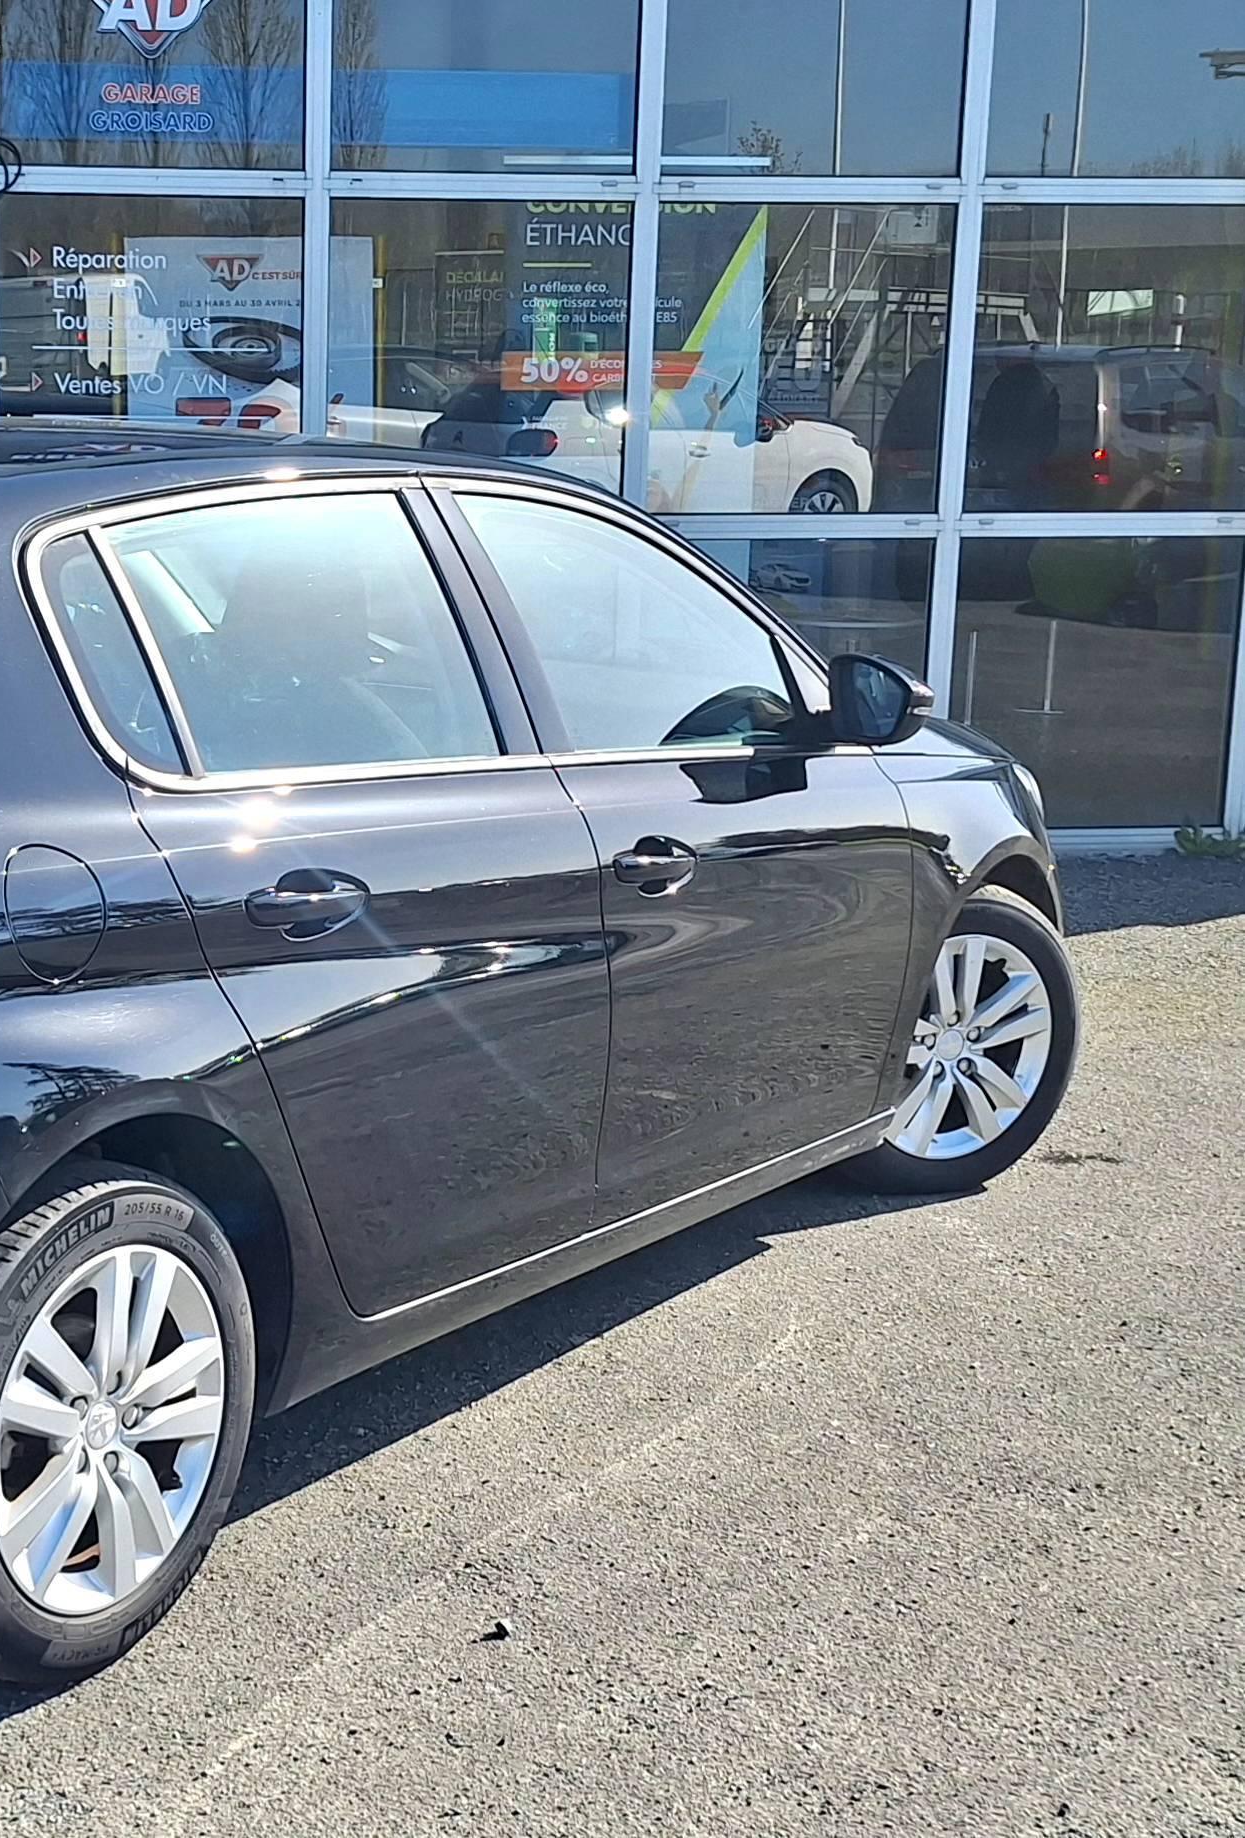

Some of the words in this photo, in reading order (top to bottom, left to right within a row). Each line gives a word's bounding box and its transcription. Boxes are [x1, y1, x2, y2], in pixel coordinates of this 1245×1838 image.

[101, 82, 201, 104] GARAGE
[89, 110, 215, 132] GROISARD
[526, 201, 717, 214] CONVEION
[526, 218, 630, 246] ÉTHAN
[52, 246, 167, 275] Réparation
[213, 258, 251, 281] AD
[523, 282, 537, 293] Le
[540, 281, 582, 293] réflexe
[585, 281, 610, 295] éco,
[235, 300, 247, 308] AU
[522, 297, 596, 308] convertissez
[53, 309, 114, 330] Tous
[127, 315, 212, 337] rques
[522, 313, 569, 324] essence
[572, 313, 587, 324] au
[589, 311, 627, 324] bioéth
[656, 311, 678, 323] E85
[520, 357, 589, 383] 50%
[54, 372, 122, 394] Ventes
[129, 373, 165, 395] VO
[172, 372, 185, 395] /
[191, 374, 227, 394] VN
[20, 1205, 111, 1298] MICHELIN
[123, 1202, 162, 1216] 205/55
[164, 1205, 172, 1217] R
